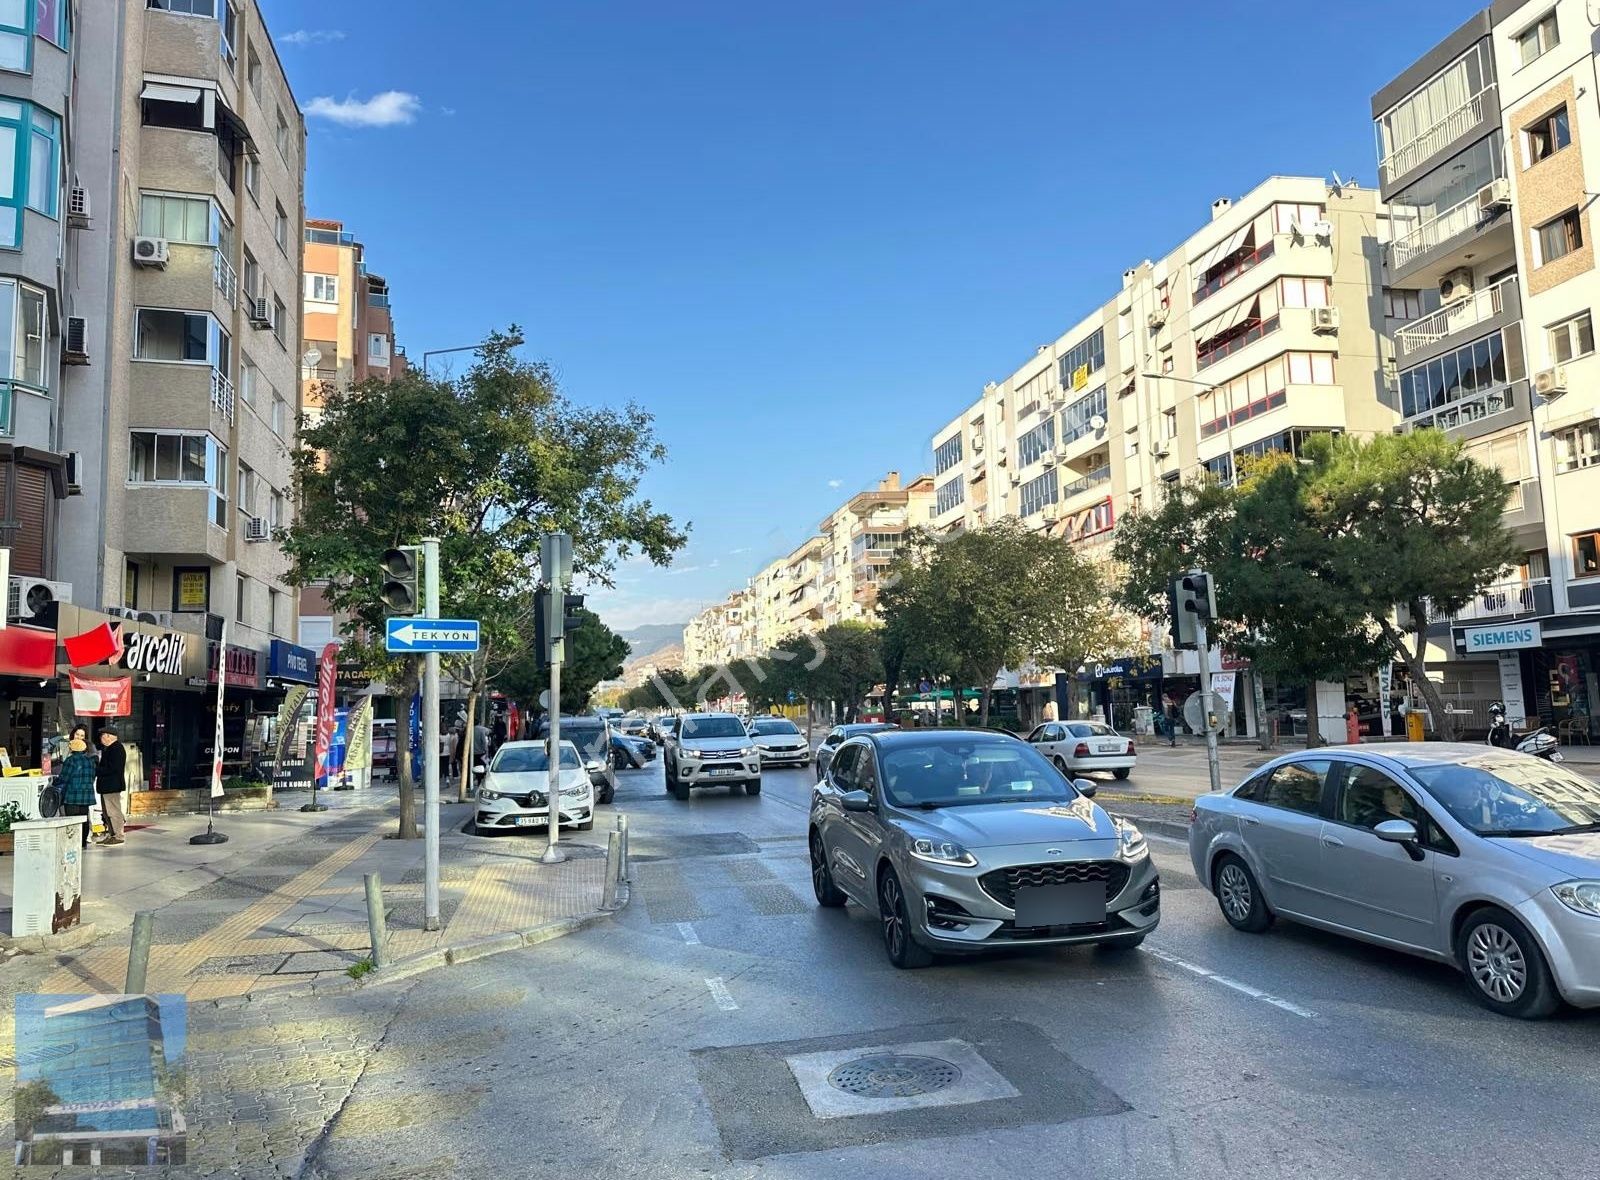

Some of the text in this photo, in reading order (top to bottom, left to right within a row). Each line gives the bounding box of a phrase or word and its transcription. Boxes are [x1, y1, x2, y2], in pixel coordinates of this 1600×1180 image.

[413, 631, 438, 640] TEK
[1472, 629, 1532, 646] SIEMENS
[126, 631, 186, 682] arçelik
